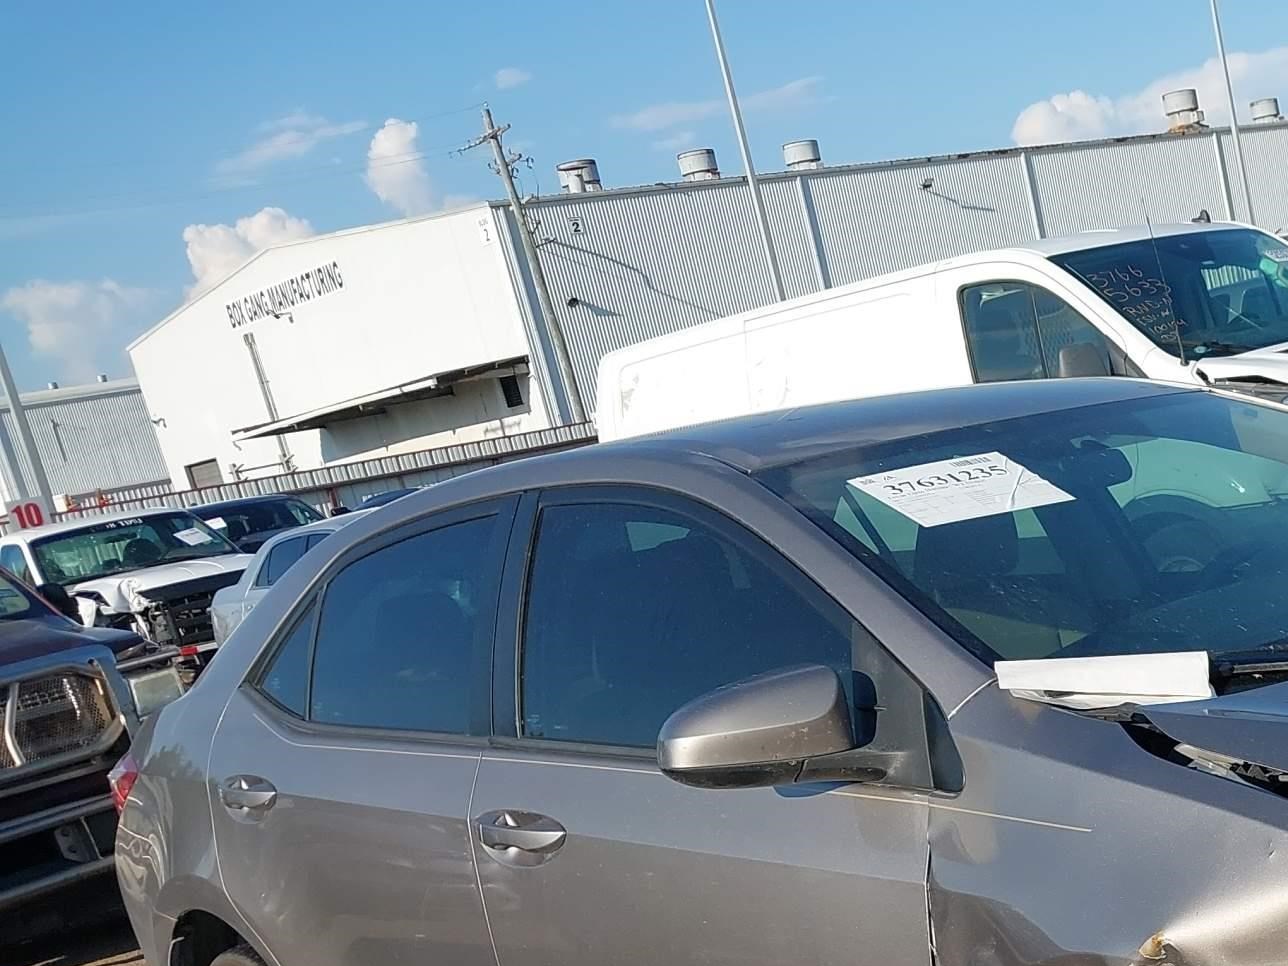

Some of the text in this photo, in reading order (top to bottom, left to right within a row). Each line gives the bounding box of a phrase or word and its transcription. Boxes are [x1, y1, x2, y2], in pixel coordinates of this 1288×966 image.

[572, 222, 581, 232] 2
[226, 261, 343, 328] BOX GANG MANUFACTURING
[883, 465, 1007, 495] 37631235
[11, 503, 43, 528] 10
